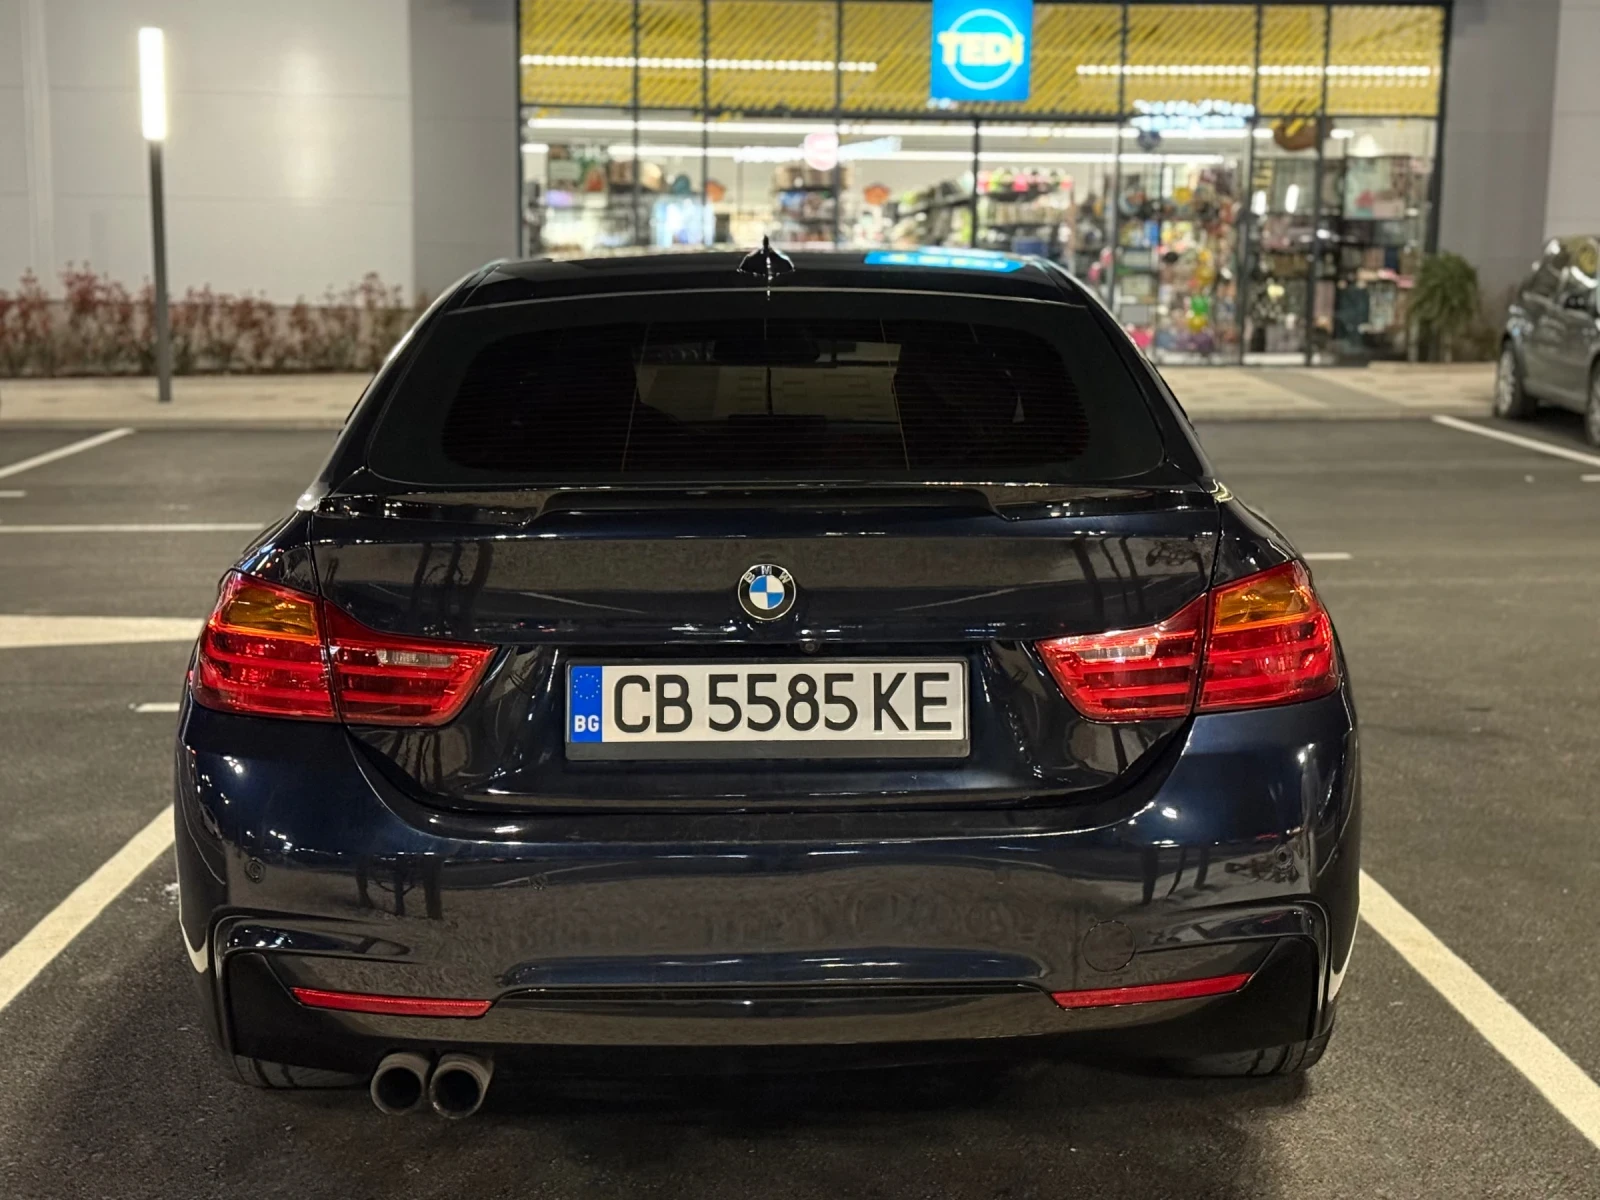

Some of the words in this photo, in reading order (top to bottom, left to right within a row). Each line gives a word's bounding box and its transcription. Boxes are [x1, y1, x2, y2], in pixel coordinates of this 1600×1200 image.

[743, 565, 791, 584] BMW
[614, 674, 693, 733] CB
[708, 673, 858, 732] 5585
[873, 672, 952, 731] KE
[574, 714, 600, 733] BG
